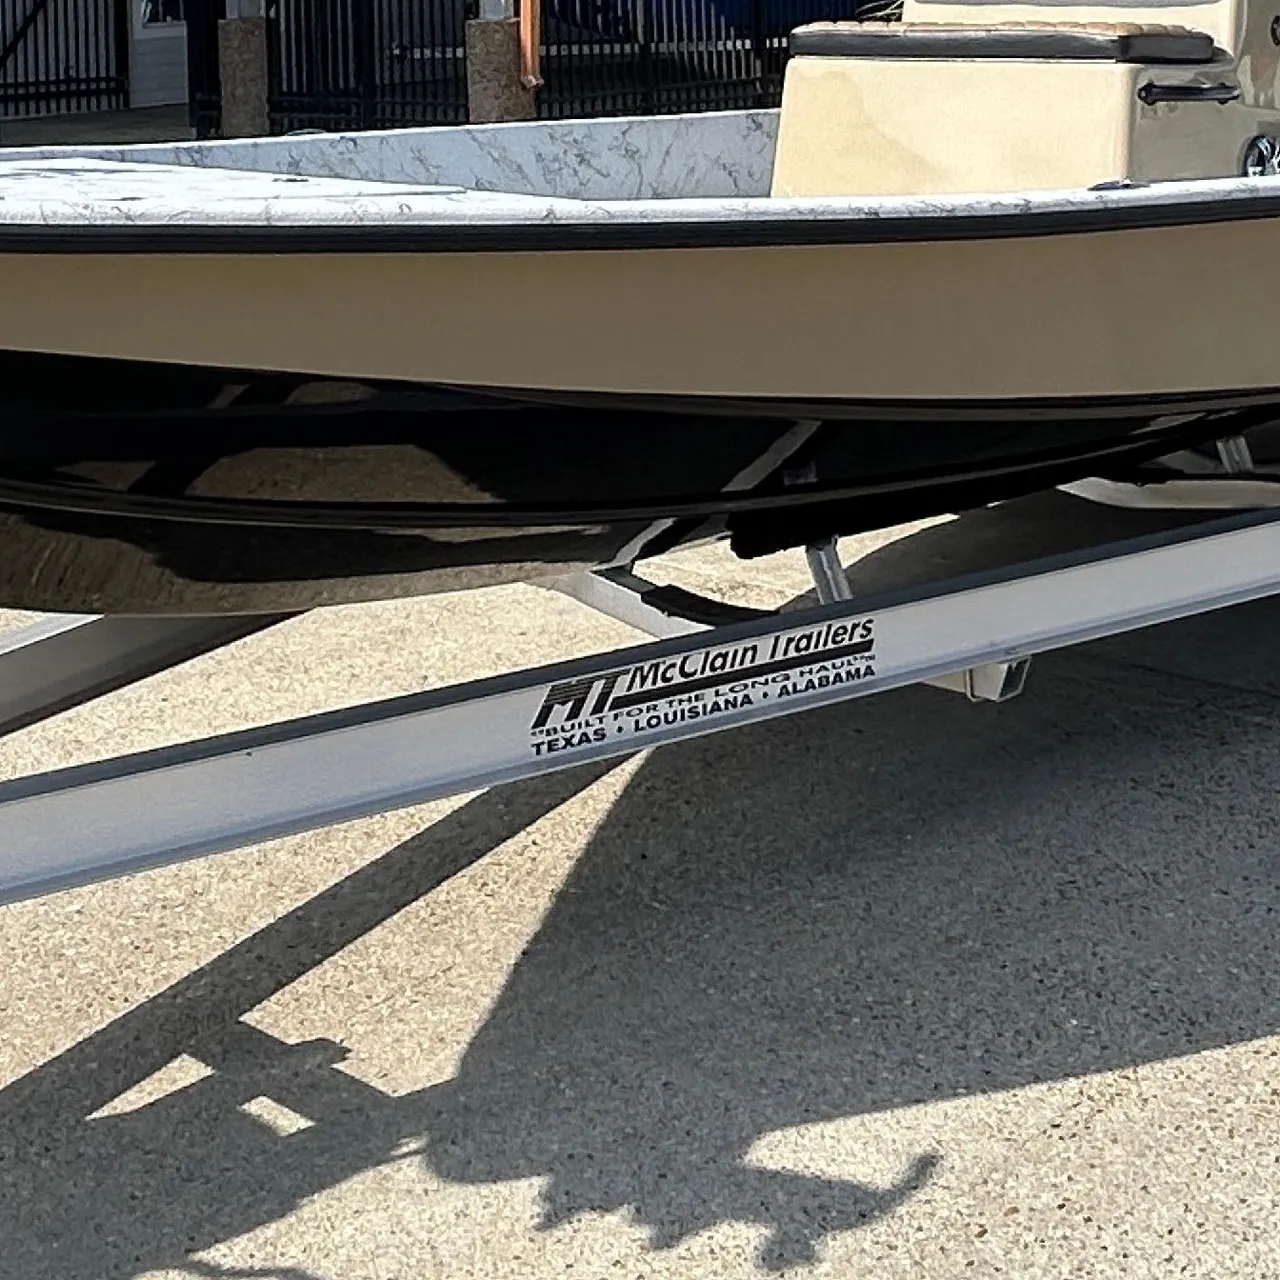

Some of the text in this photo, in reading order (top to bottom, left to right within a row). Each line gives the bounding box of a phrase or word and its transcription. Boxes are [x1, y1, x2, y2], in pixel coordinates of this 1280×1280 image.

[626, 618, 875, 693] McClain Trailers
[531, 664, 876, 756] TEXAS LOUISIANA ALABAMA
[613, 703, 659, 721] FOR
[664, 692, 705, 708] THE
[715, 673, 791, 697] LONG
